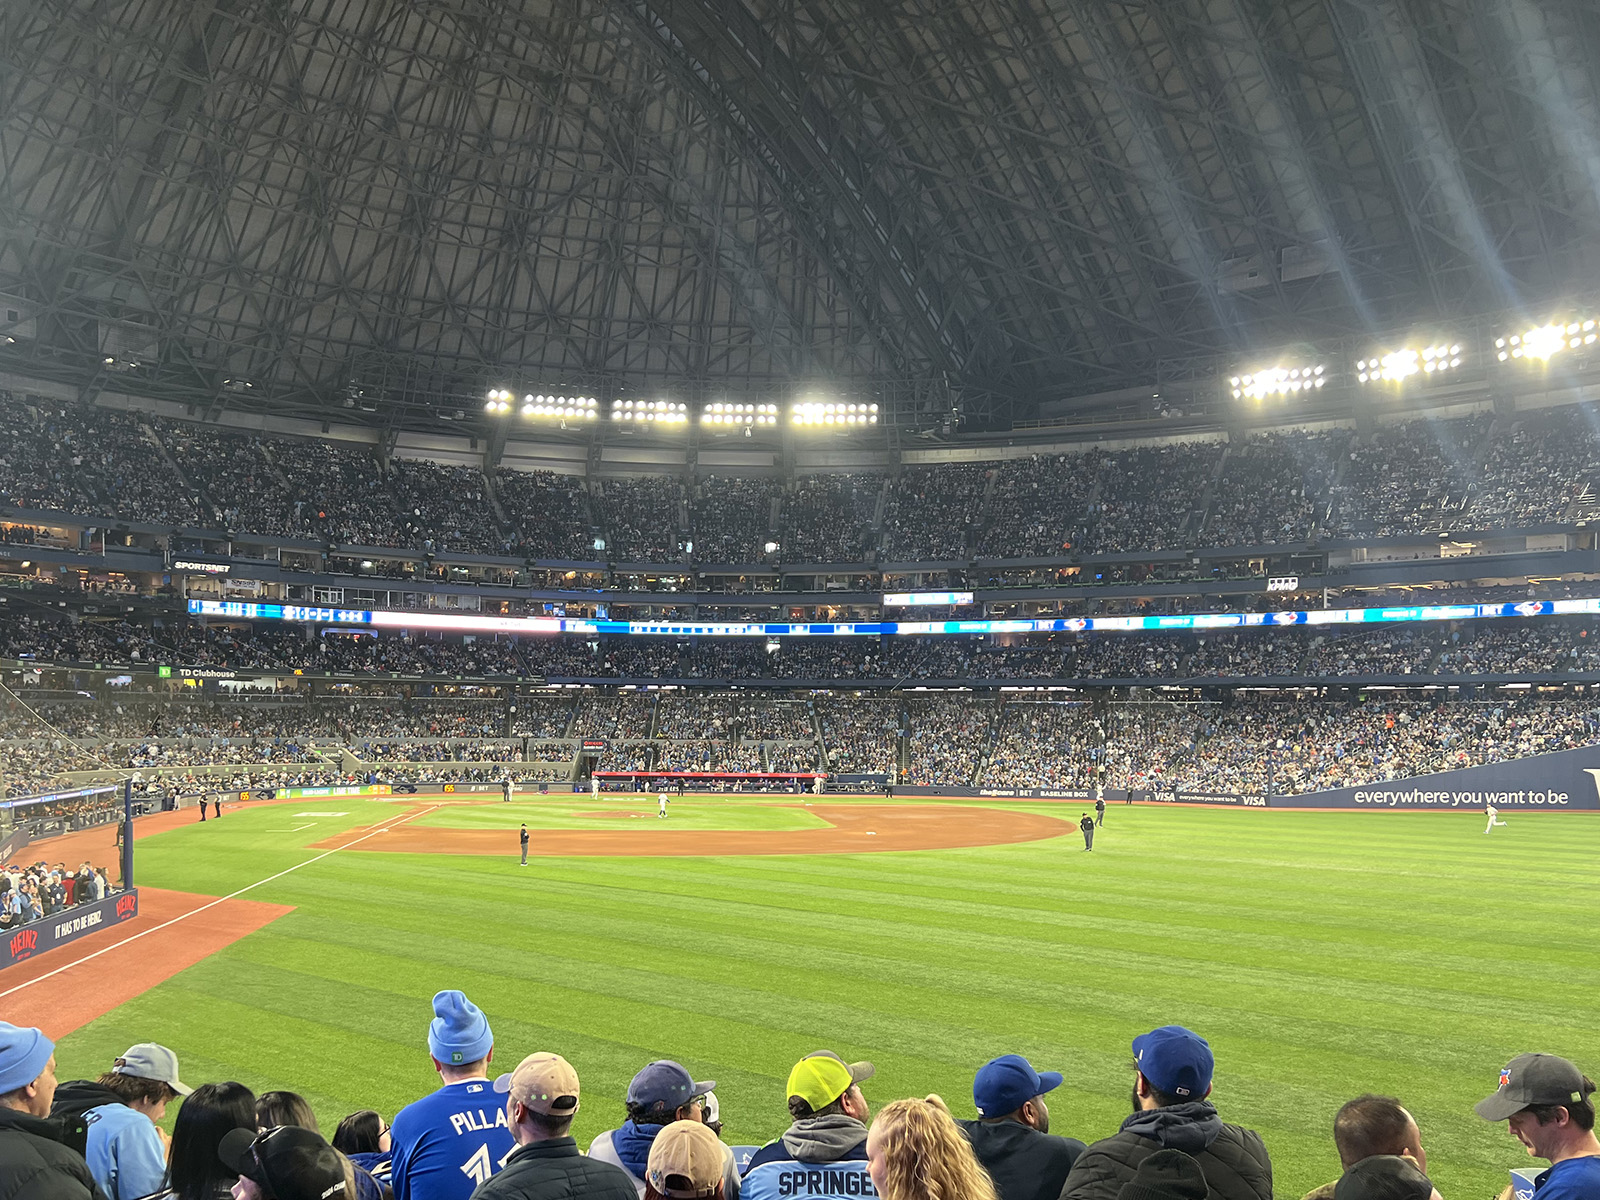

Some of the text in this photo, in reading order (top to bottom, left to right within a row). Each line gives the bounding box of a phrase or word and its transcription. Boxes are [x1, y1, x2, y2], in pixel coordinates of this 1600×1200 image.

[174, 561, 231, 573] SPORTSNET
[180, 668, 236, 678] TD Clubhouse
[1153, 791, 1176, 802] VISA
[1179, 794, 1205, 802] everywhere
[1241, 795, 1266, 806] VISA
[1354, 788, 1569, 806] everywhere you want to be
[116, 894, 137, 917] HEINZ
[54, 924, 61, 939] IT
[61, 922, 73, 936] HAS
[72, 918, 81, 932] TO
[80, 916, 88, 930] BE
[10, 929, 38, 958] HEINZ
[452, 1053, 463, 1061] TD
[449, 1107, 508, 1136] PILLA
[778, 1170, 880, 1196] SPRINGE
